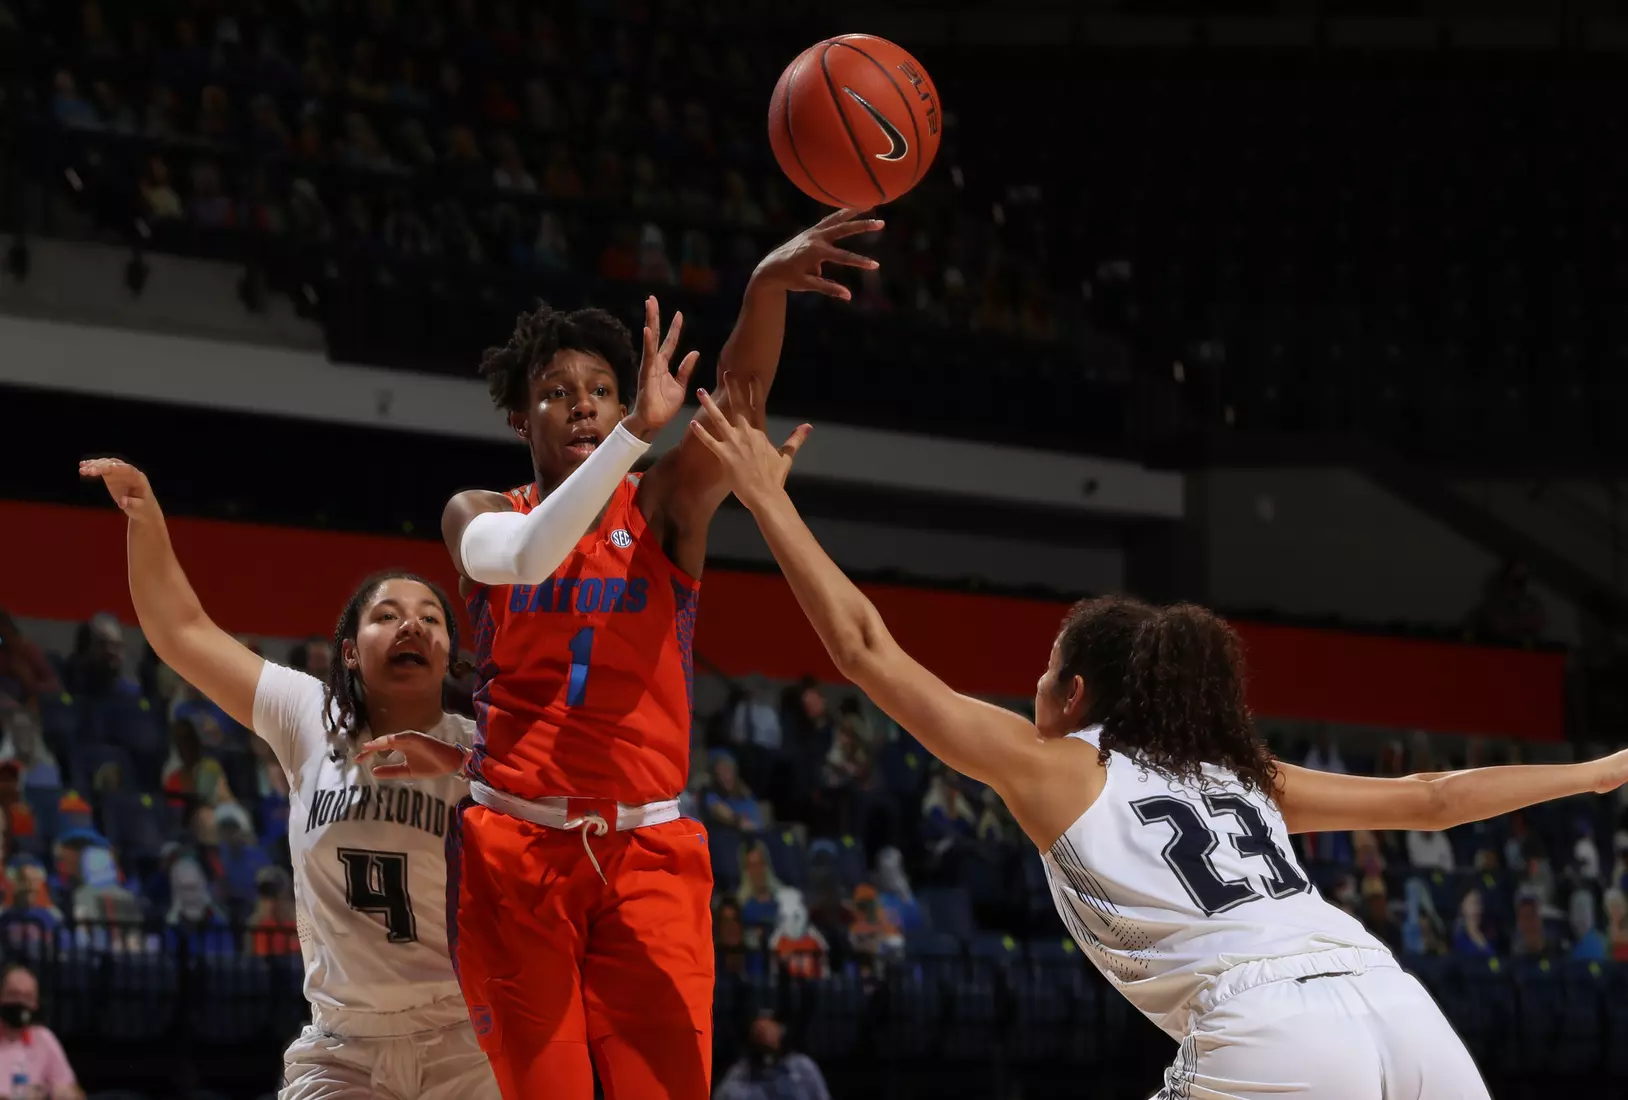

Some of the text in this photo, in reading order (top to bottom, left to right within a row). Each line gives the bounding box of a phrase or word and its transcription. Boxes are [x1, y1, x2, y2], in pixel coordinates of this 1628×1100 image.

[897, 59, 938, 137] ELITE
[611, 530, 632, 547] SEC
[509, 577, 649, 614] GATORS
[565, 626, 596, 707] 1
[304, 785, 455, 839] NORTH FLORID
[1128, 792, 1314, 918] 23
[336, 846, 419, 944] 4
